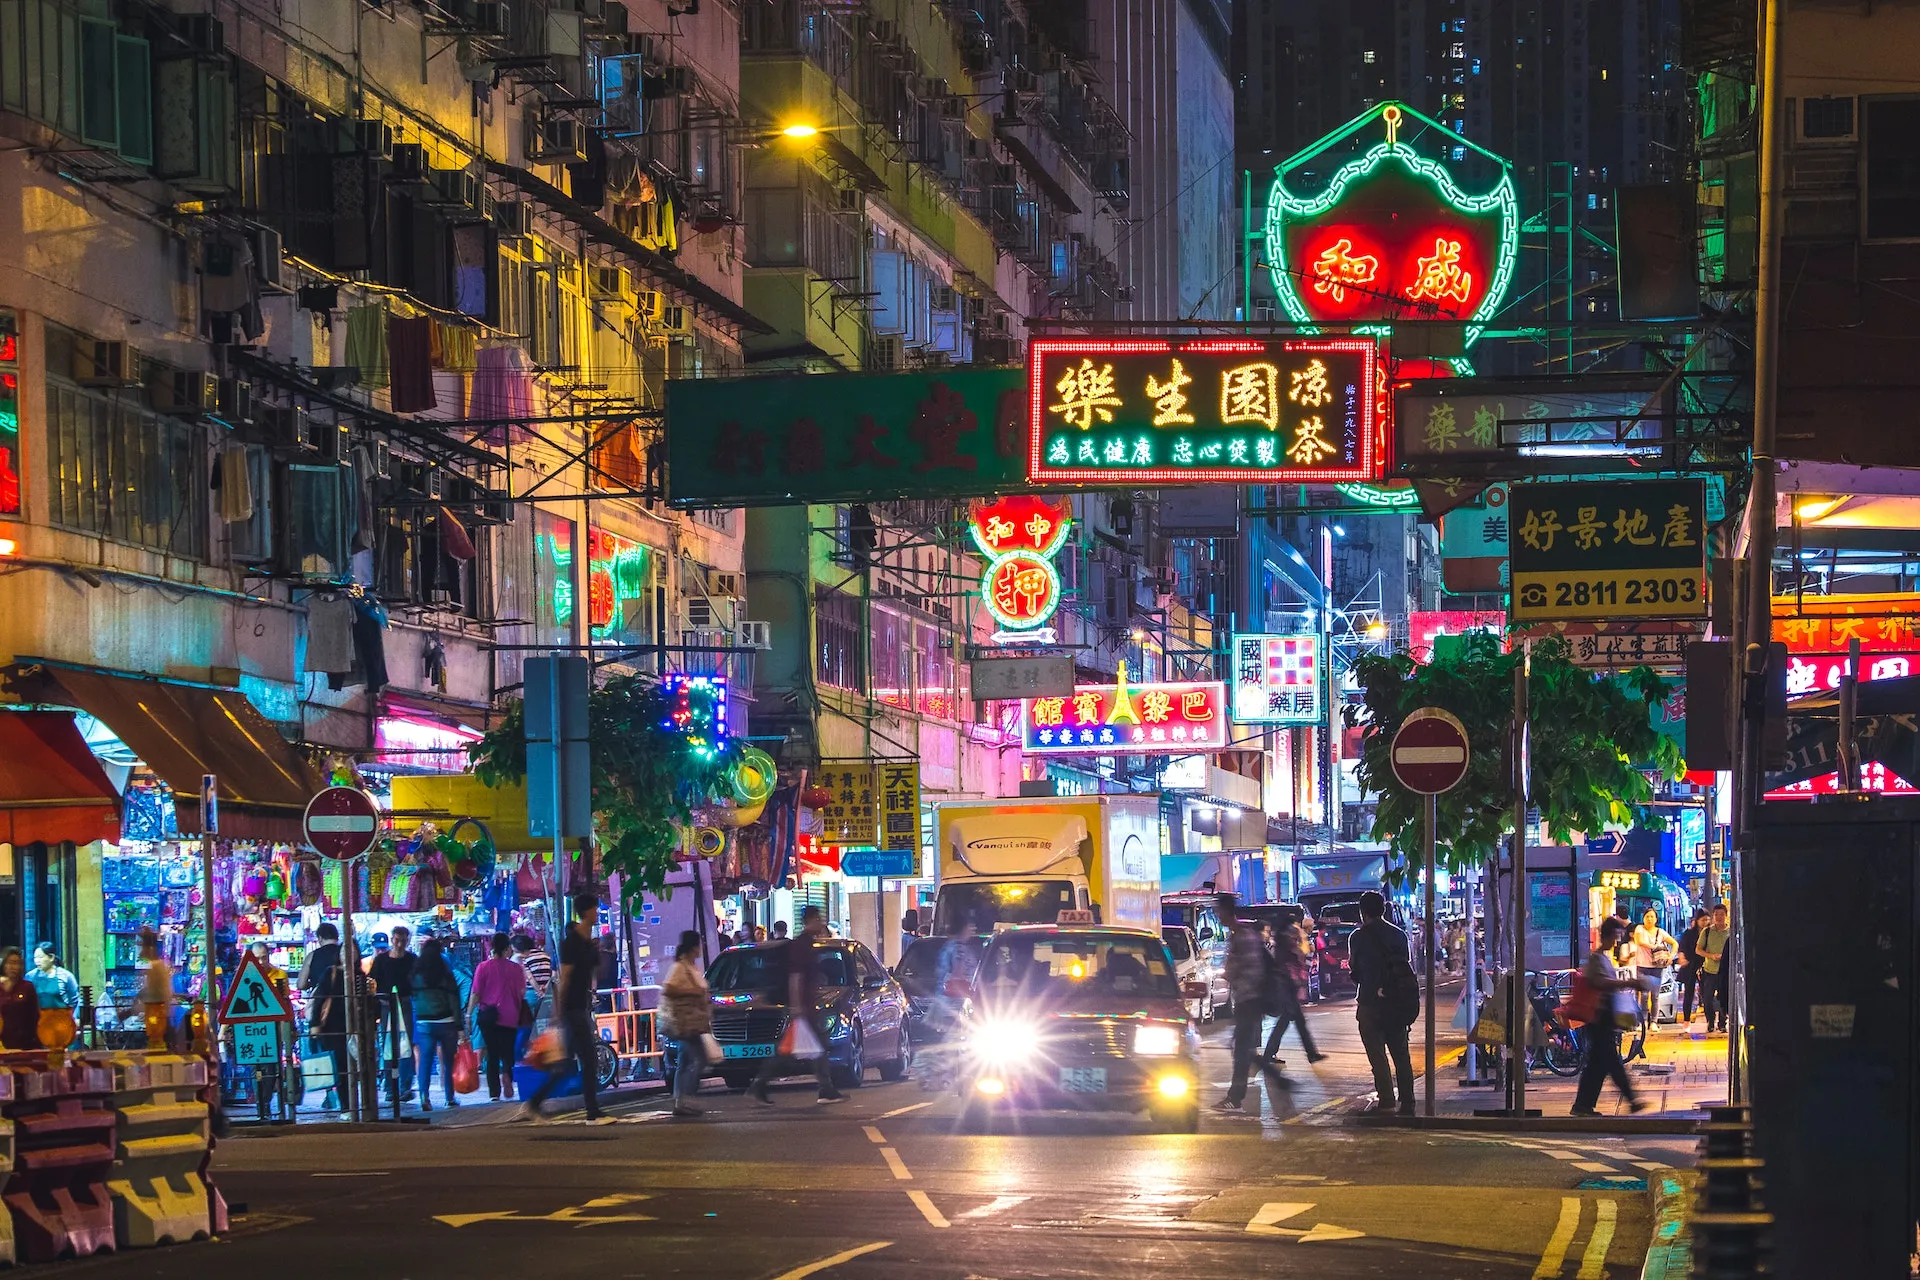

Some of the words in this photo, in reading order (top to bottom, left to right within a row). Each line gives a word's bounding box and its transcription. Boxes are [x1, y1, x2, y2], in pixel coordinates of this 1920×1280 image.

[1049, 358, 1278, 431] 樂生園
[1519, 503, 1697, 552] 好景地產
[1555, 579, 1618, 606] 2811
[1624, 577, 1697, 605] 2303
[976, 841, 1026, 850] Vanquish
[1061, 912, 1092, 922] TAXI
[244, 1025, 267, 1036] End
[240, 1042, 274, 1059] 終止
[742, 1046, 773, 1057] 5268
